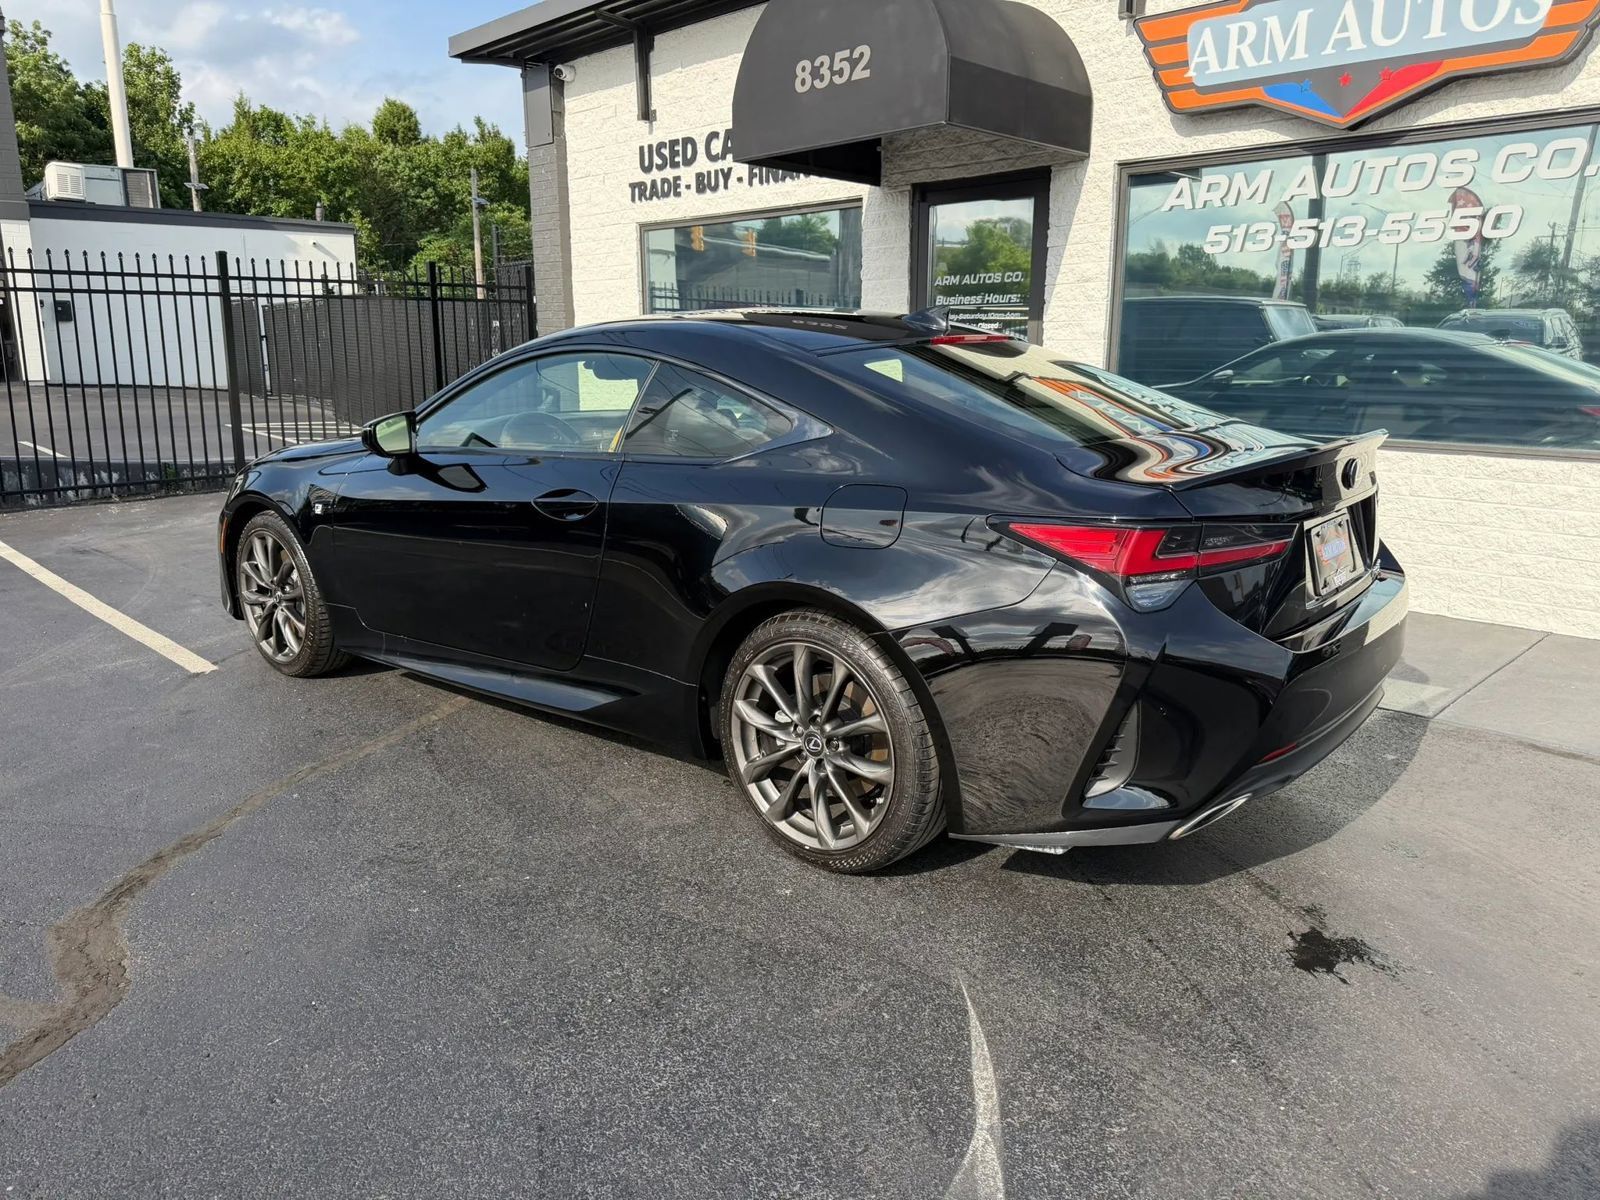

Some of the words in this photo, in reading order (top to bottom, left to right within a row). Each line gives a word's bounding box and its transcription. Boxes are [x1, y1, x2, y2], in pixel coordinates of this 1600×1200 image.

[1184, 8, 1314, 78] ARM
[794, 44, 871, 93] 8352
[638, 136, 698, 174] USED
[704, 128, 733, 163] CA
[1161, 168, 1275, 212] ARM
[1280, 148, 1480, 203] AUTOS
[1491, 137, 1600, 184] CO.
[628, 175, 682, 203] TRADE
[695, 167, 733, 194] BUY
[1203, 204, 1524, 254] 513-513-5550
[934, 274, 960, 286] ARM
[961, 273, 1002, 285] AUTOS
[1004, 271, 1024, 283] CO.
[935, 294, 983, 306] Business
[984, 292, 1021, 304] Hours:
